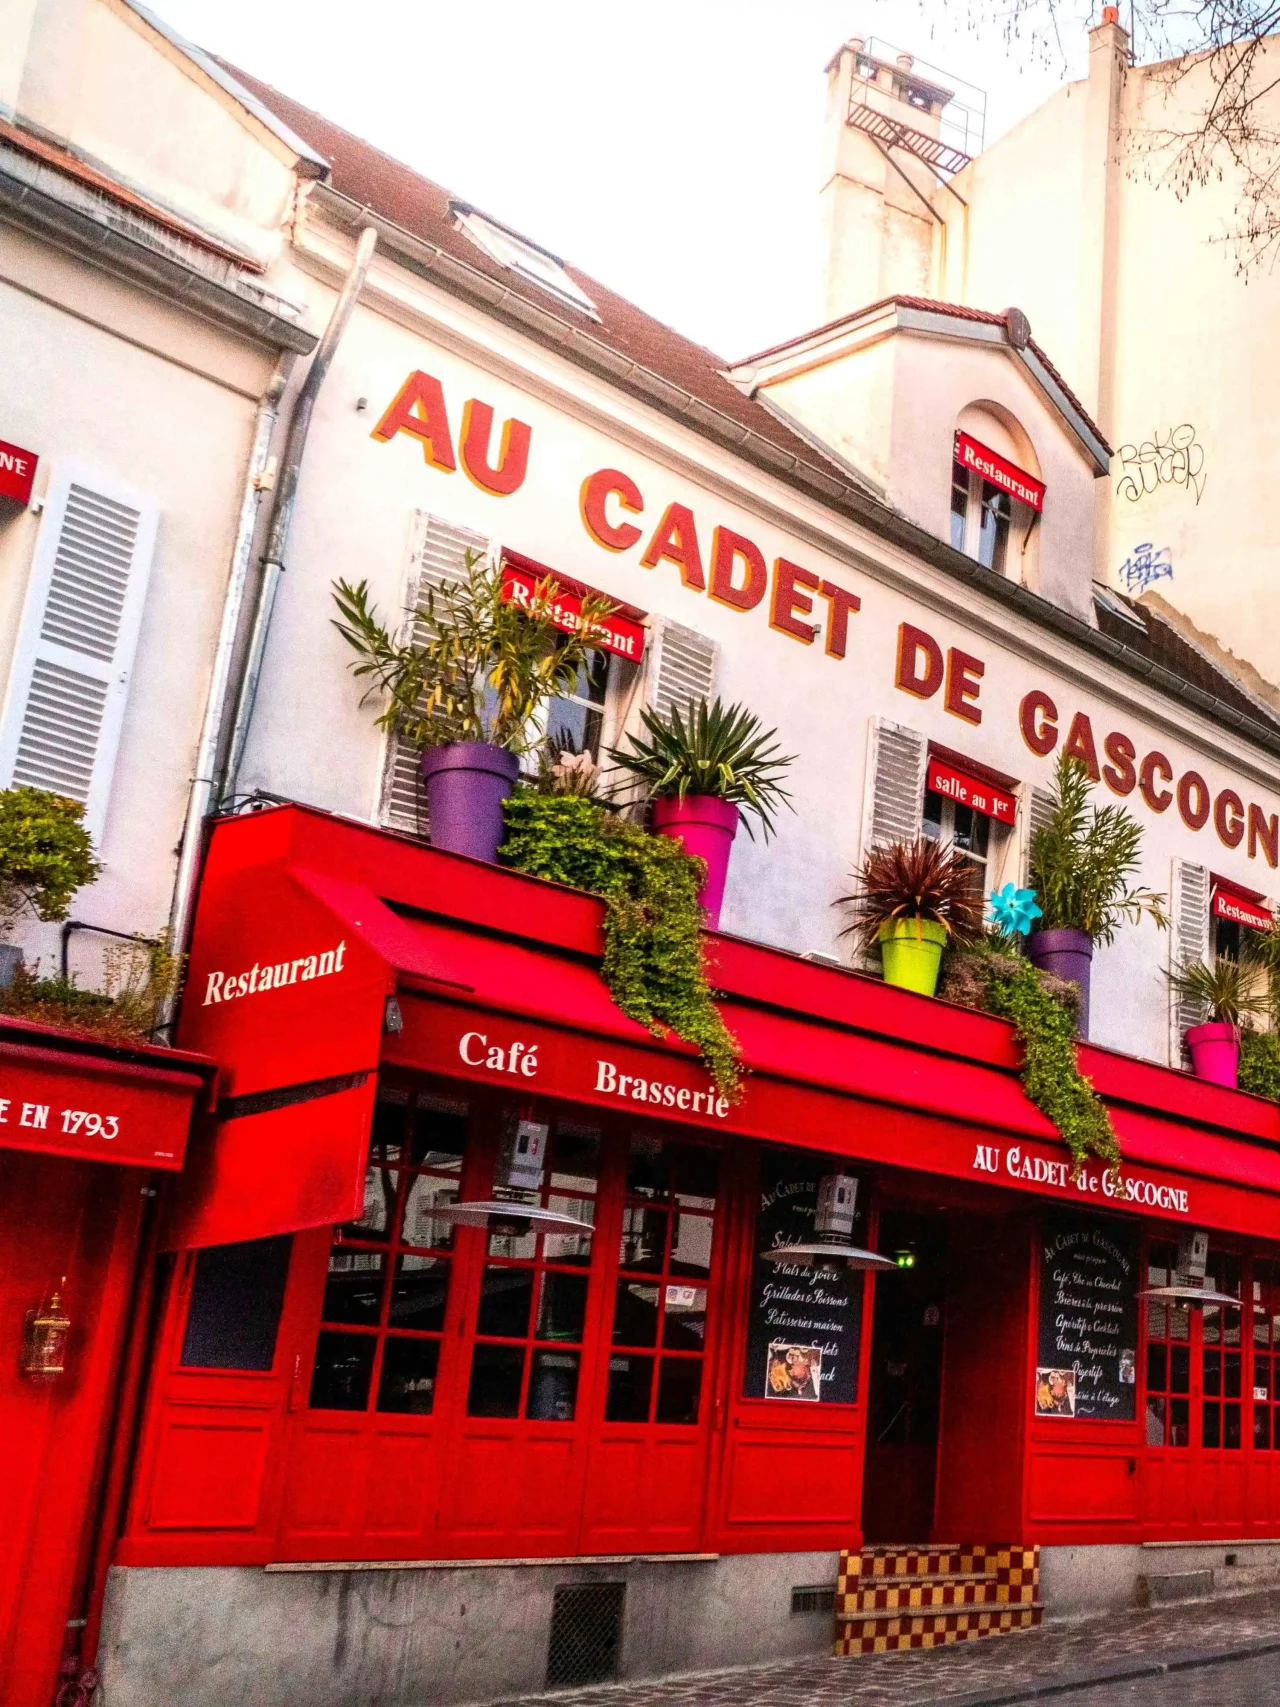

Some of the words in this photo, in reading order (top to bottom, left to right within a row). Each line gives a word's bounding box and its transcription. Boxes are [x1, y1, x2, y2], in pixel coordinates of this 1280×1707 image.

[964, 444, 1039, 506] Restaurant
[369, 369, 532, 497] AU
[579, 468, 861, 660] CADET
[895, 622, 985, 726] DE
[935, 775, 967, 800] salle
[972, 794, 986, 810] au
[992, 797, 1009, 816] 1er
[202, 940, 346, 1006] Restaurant
[459, 1032, 539, 1077] Café
[594, 1060, 729, 1118] Brasserie
[19, 1102, 50, 1129] EN
[60, 1109, 120, 1140] 1793
[973, 1144, 1000, 1172] AU
[1006, 1146, 1068, 1187] CADET
[1077, 1169, 1098, 1192] de
[1102, 1168, 1189, 1213] GASCOGNE
[760, 1283, 805, 1308] Grillades
[812, 1318, 844, 1332] maison
